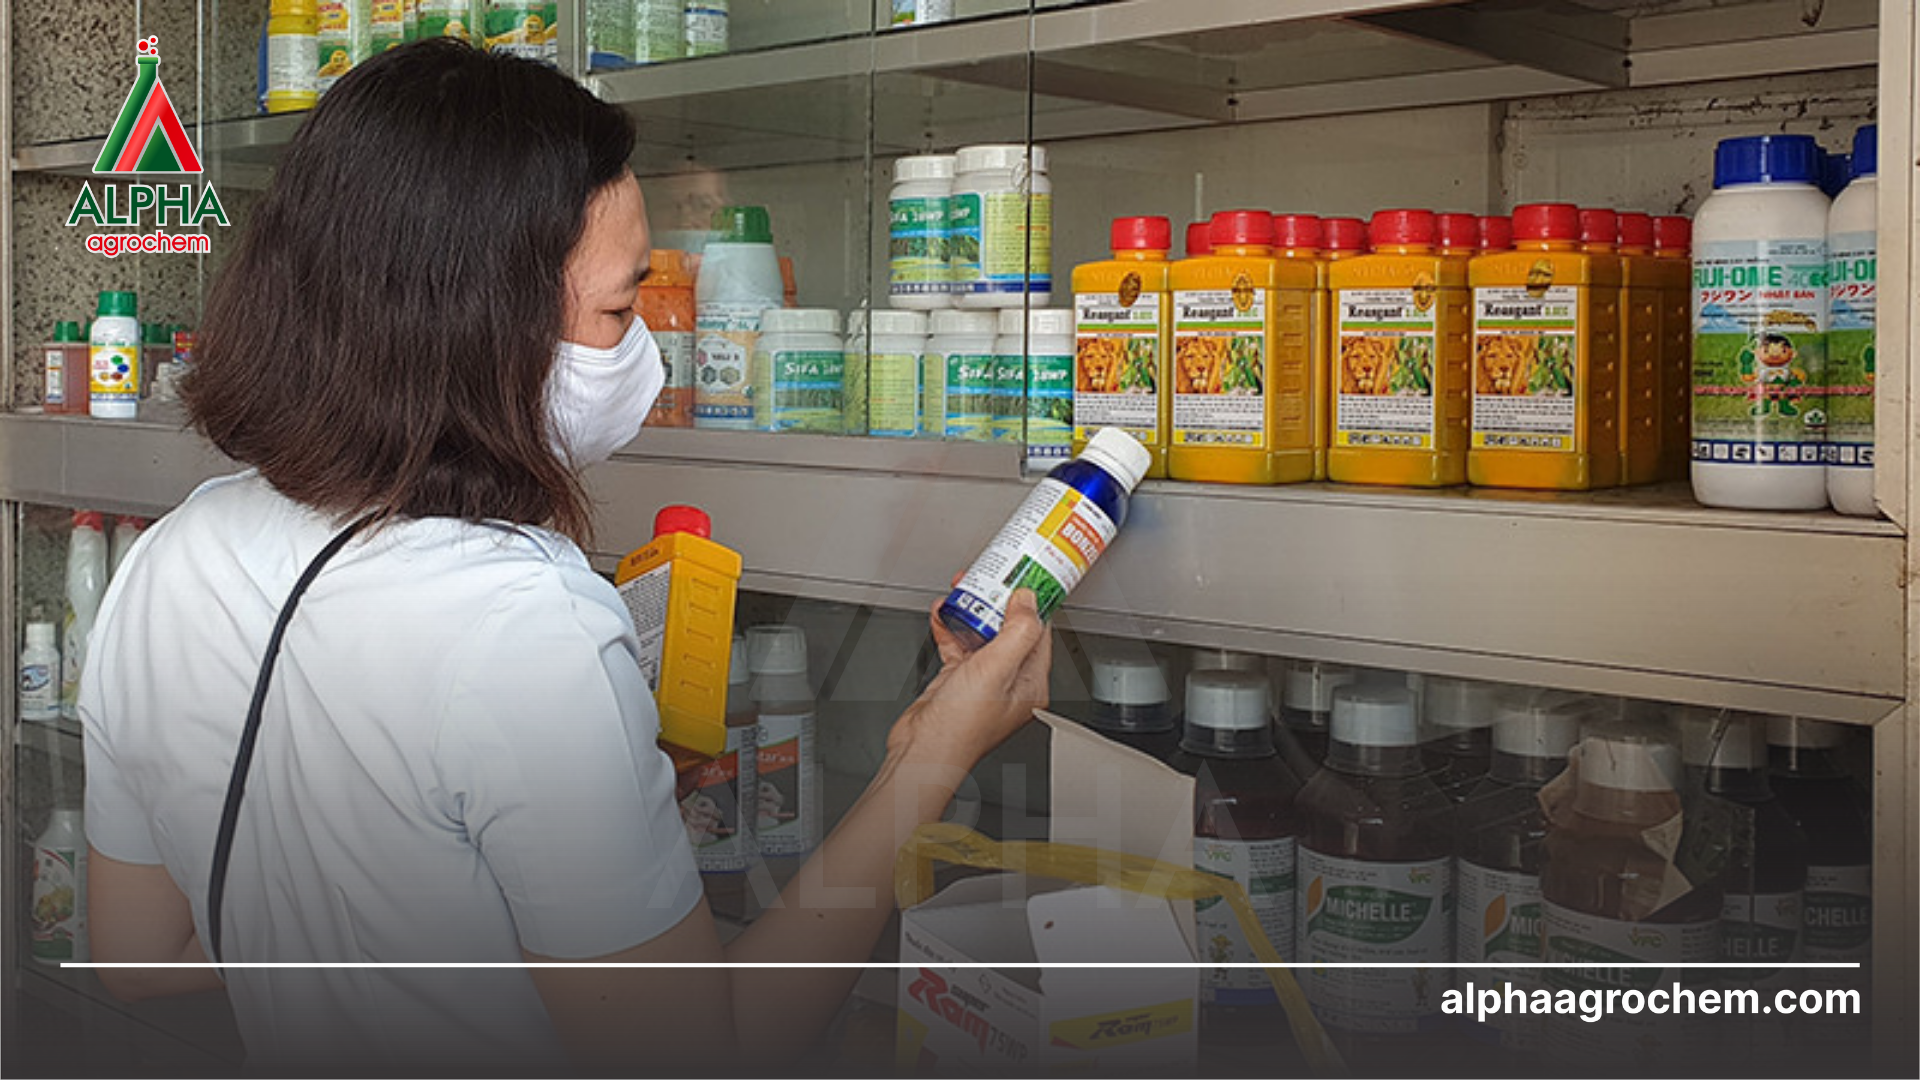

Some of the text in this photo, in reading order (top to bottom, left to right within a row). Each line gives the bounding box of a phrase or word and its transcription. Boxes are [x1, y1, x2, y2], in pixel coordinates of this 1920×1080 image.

[1693, 265, 1782, 288] FUJI-ONE
[1830, 284, 1876, 299] ジワン
[1325, 896, 1412, 922] MICHELLE
[1805, 907, 1868, 926] CHELLE
